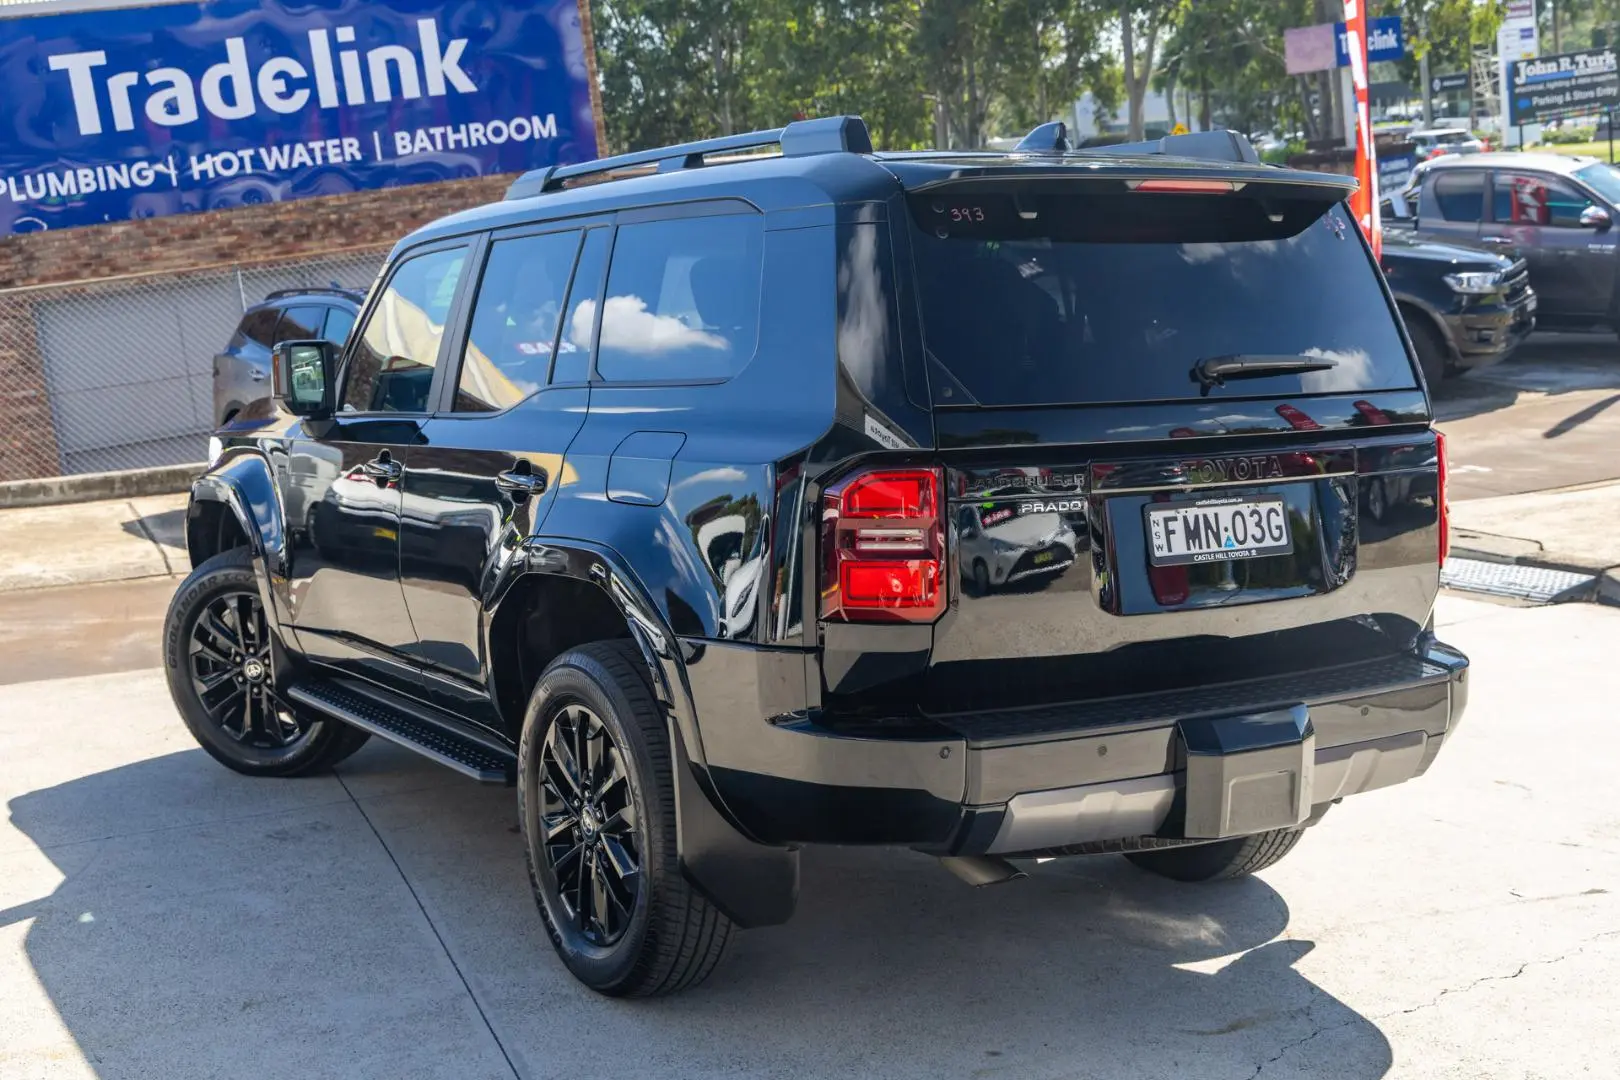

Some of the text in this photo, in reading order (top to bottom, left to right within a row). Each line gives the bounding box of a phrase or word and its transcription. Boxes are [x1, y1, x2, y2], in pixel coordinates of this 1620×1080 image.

[49, 18, 477, 135] Tradelink
[1514, 59, 1558, 85] John
[1574, 50, 1617, 71] Turk
[394, 114, 558, 156] BATHROOM
[191, 136, 362, 181] HOT WATER
[951, 206, 984, 224] 393
[1179, 455, 1284, 483] TOYOTA
[1021, 501, 1082, 513] PRADO
[1194, 550, 1250, 561] CASTLE HILL TOYOTA
